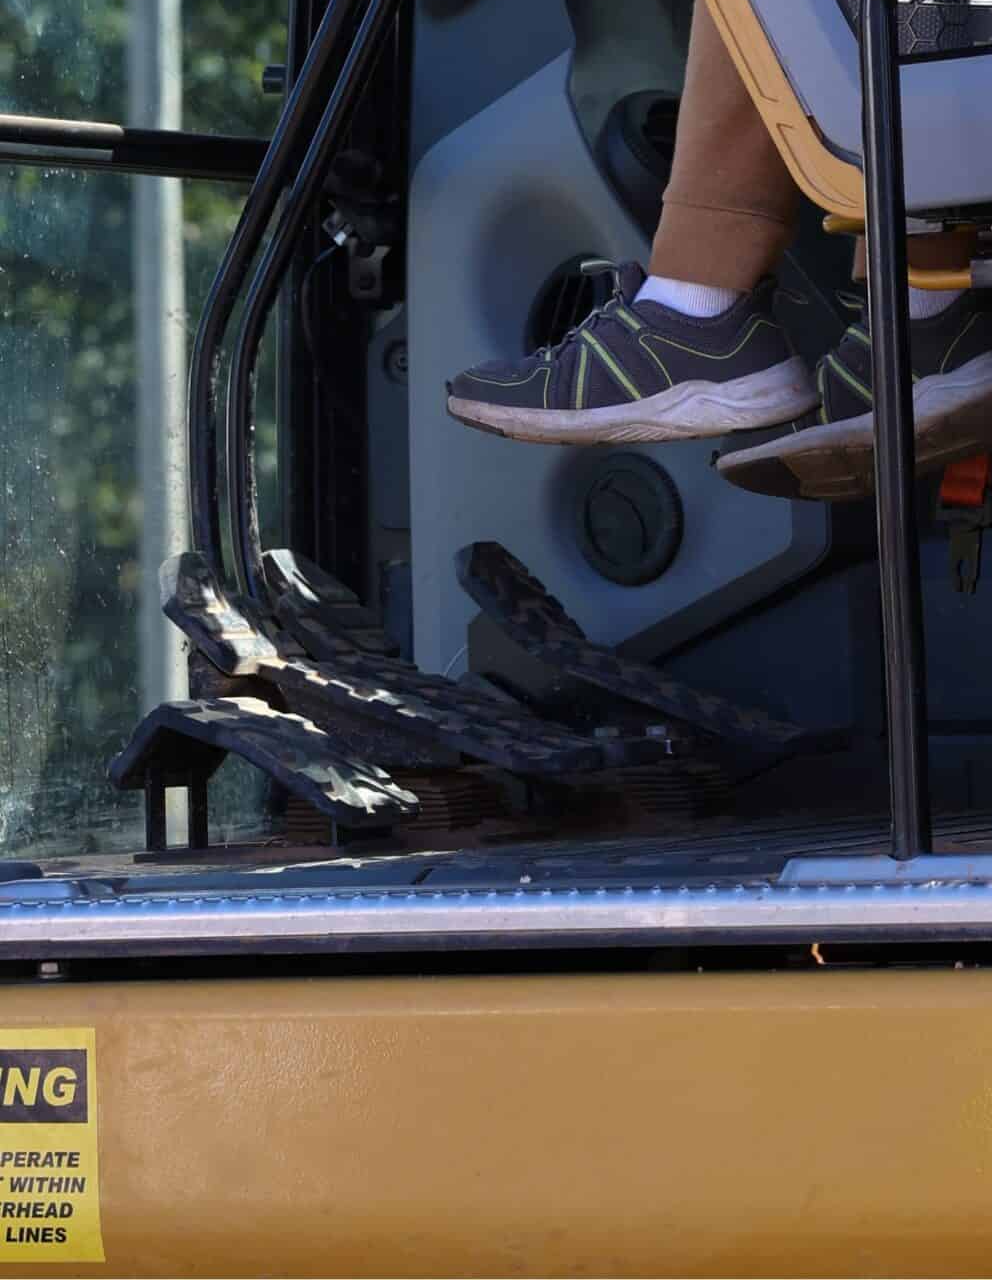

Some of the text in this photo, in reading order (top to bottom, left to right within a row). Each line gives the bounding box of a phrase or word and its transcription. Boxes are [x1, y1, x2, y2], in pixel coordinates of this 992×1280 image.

[0, 1066, 78, 1107] NG
[0, 1151, 81, 1168] PERATE
[10, 1177, 86, 1194] WITHIN
[0, 1201, 74, 1218] RHEAD
[6, 1226, 68, 1243] LINES
